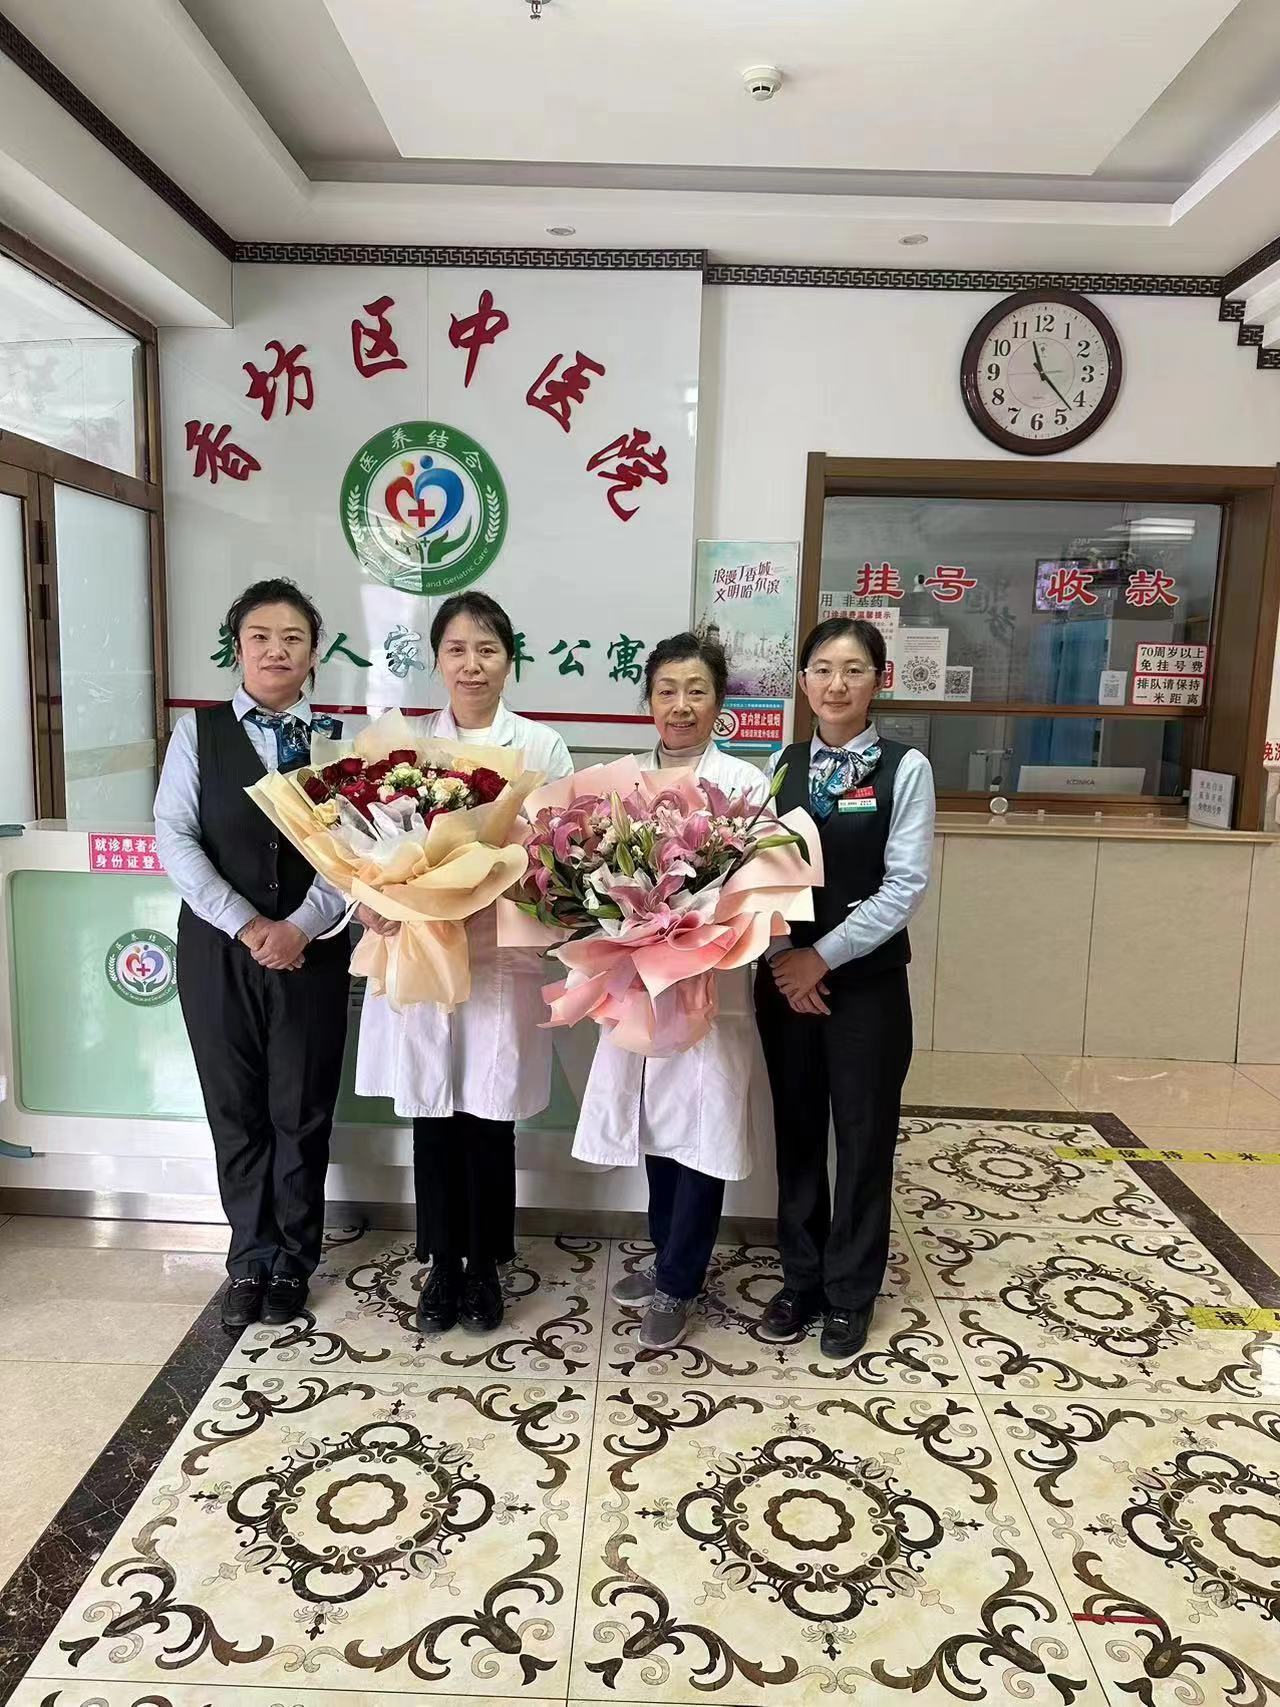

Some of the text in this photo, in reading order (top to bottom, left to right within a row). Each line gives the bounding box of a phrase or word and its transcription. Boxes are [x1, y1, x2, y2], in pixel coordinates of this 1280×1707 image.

[1012, 322, 1028, 338] 11
[1035, 315, 1054, 332] 12
[1064, 323, 1070, 339] 1
[993, 340, 1011, 356] 10
[1077, 340, 1090, 358] 2
[988, 364, 1000, 380] 9
[1081, 365, 1095, 383] 3
[992, 388, 1005, 405] 8
[1073, 390, 1086, 407] 4
[184, 289, 669, 522] 香坊区中医院
[1008, 407, 1021, 424] 7
[1031, 413, 1044, 430] 6
[1054, 408, 1067, 425] 5
[359, 428, 483, 473] 医养结合
[426, 580, 442, 588] and
[443, 565, 475, 586] Geriatric
[473, 547, 489, 566] Care
[713, 561, 772, 585] 浪漫丁香城
[714, 577, 780, 603] 文明哈尔滨
[852, 562, 977, 603] 挂号
[1046, 567, 1180, 608] 收款
[1140, 646, 1204, 659] 70周岁以上
[1140, 659, 1203, 673] 免挂号费
[1136, 678, 1201, 691] 排队请保持
[1136, 692, 1199, 705] 一米距离
[94, 837, 158, 853] 就诊患者必
